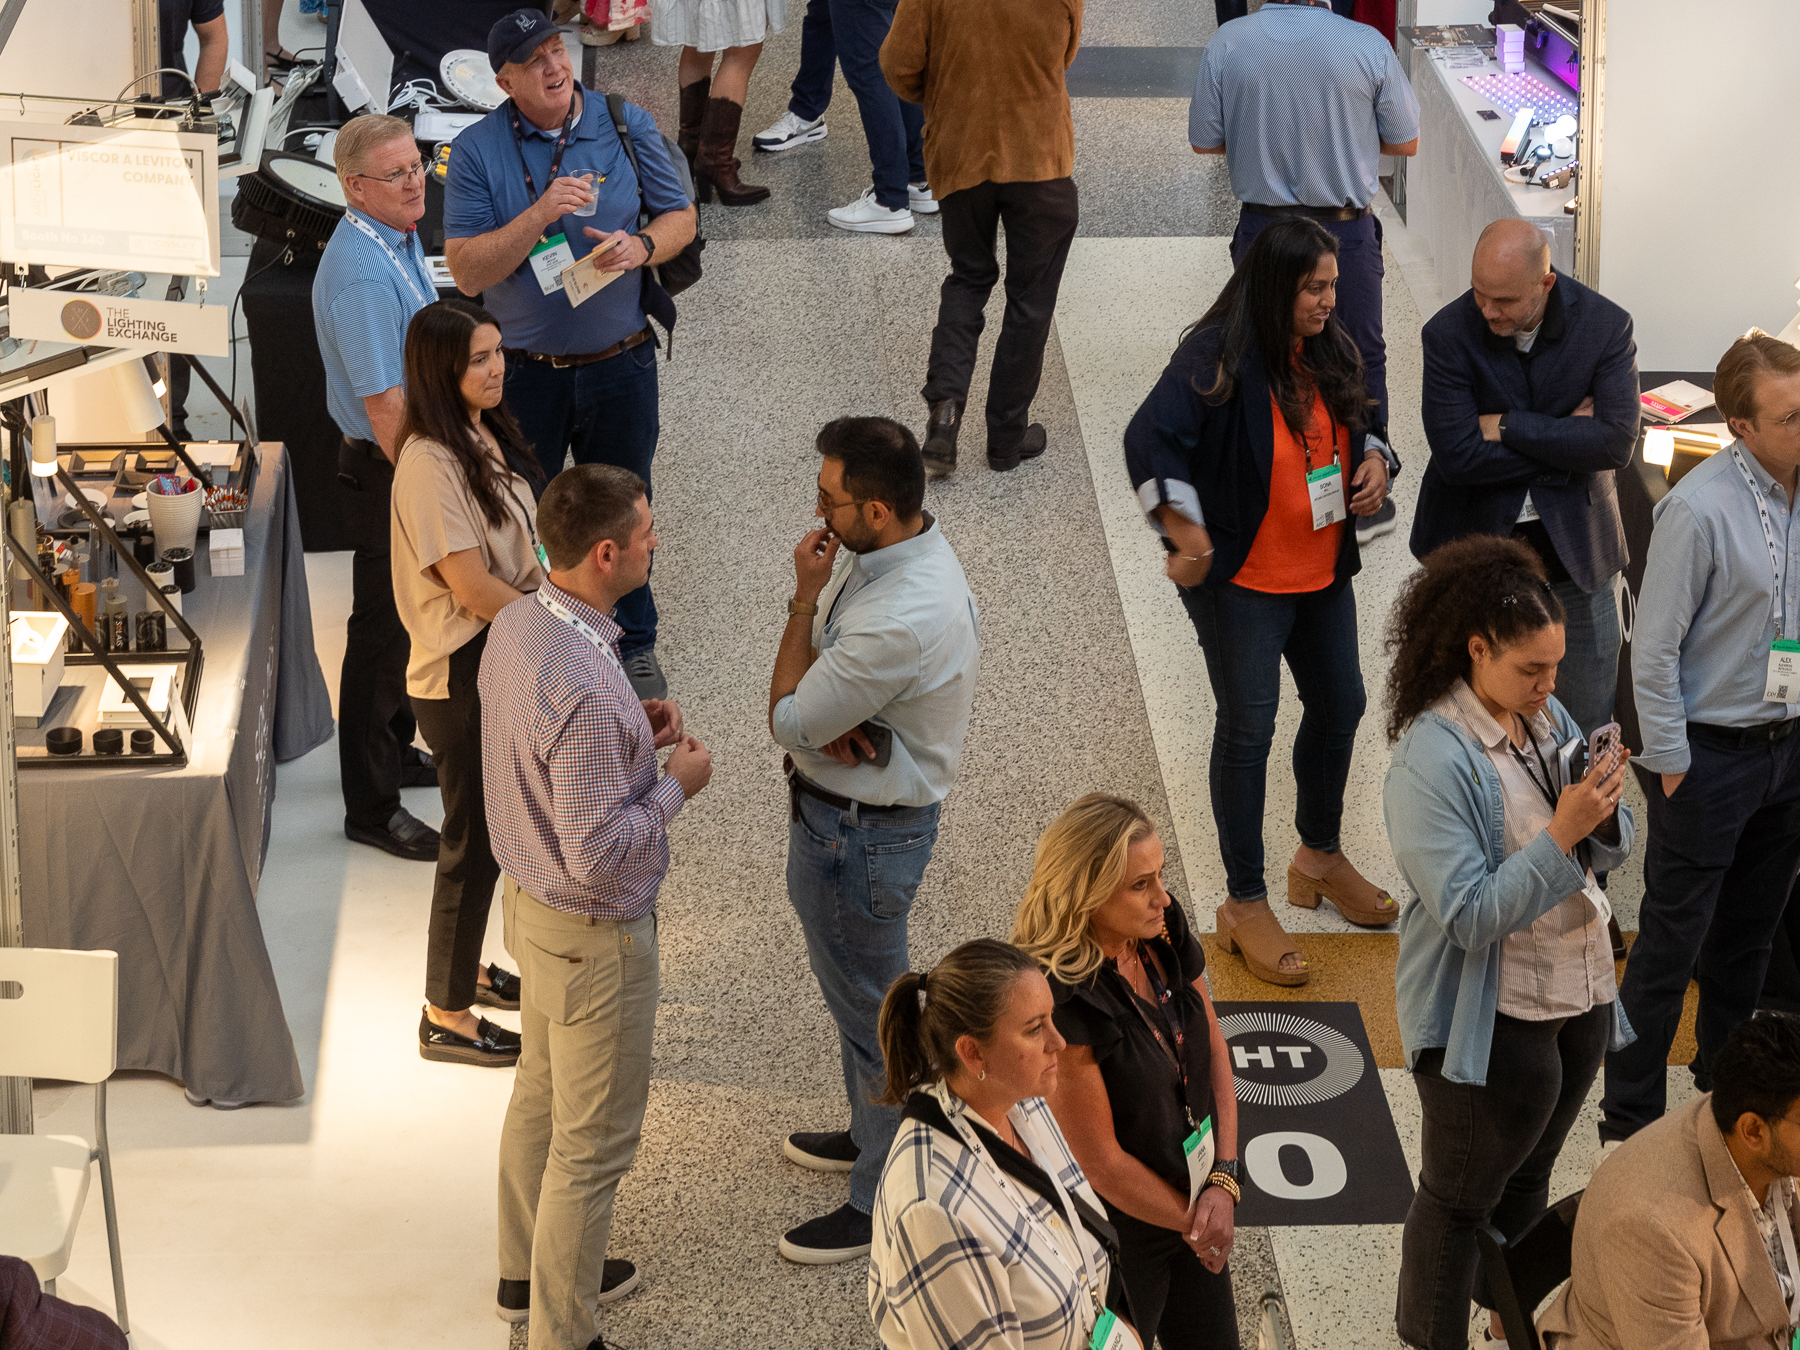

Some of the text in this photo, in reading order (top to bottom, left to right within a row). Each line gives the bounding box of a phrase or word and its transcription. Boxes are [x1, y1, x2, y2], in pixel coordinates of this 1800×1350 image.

[67, 149, 194, 169] VISCOR A LEVITON
[122, 170, 194, 187] COMPANY
[22, 229, 106, 246] Booth No 340
[149, 238, 197, 250] HOSSLEY
[542, 250, 558, 261] KEVIN
[106, 306, 130, 319] THE
[106, 317, 167, 332] LIGHTING
[106, 327, 178, 343] EXCHANGE
